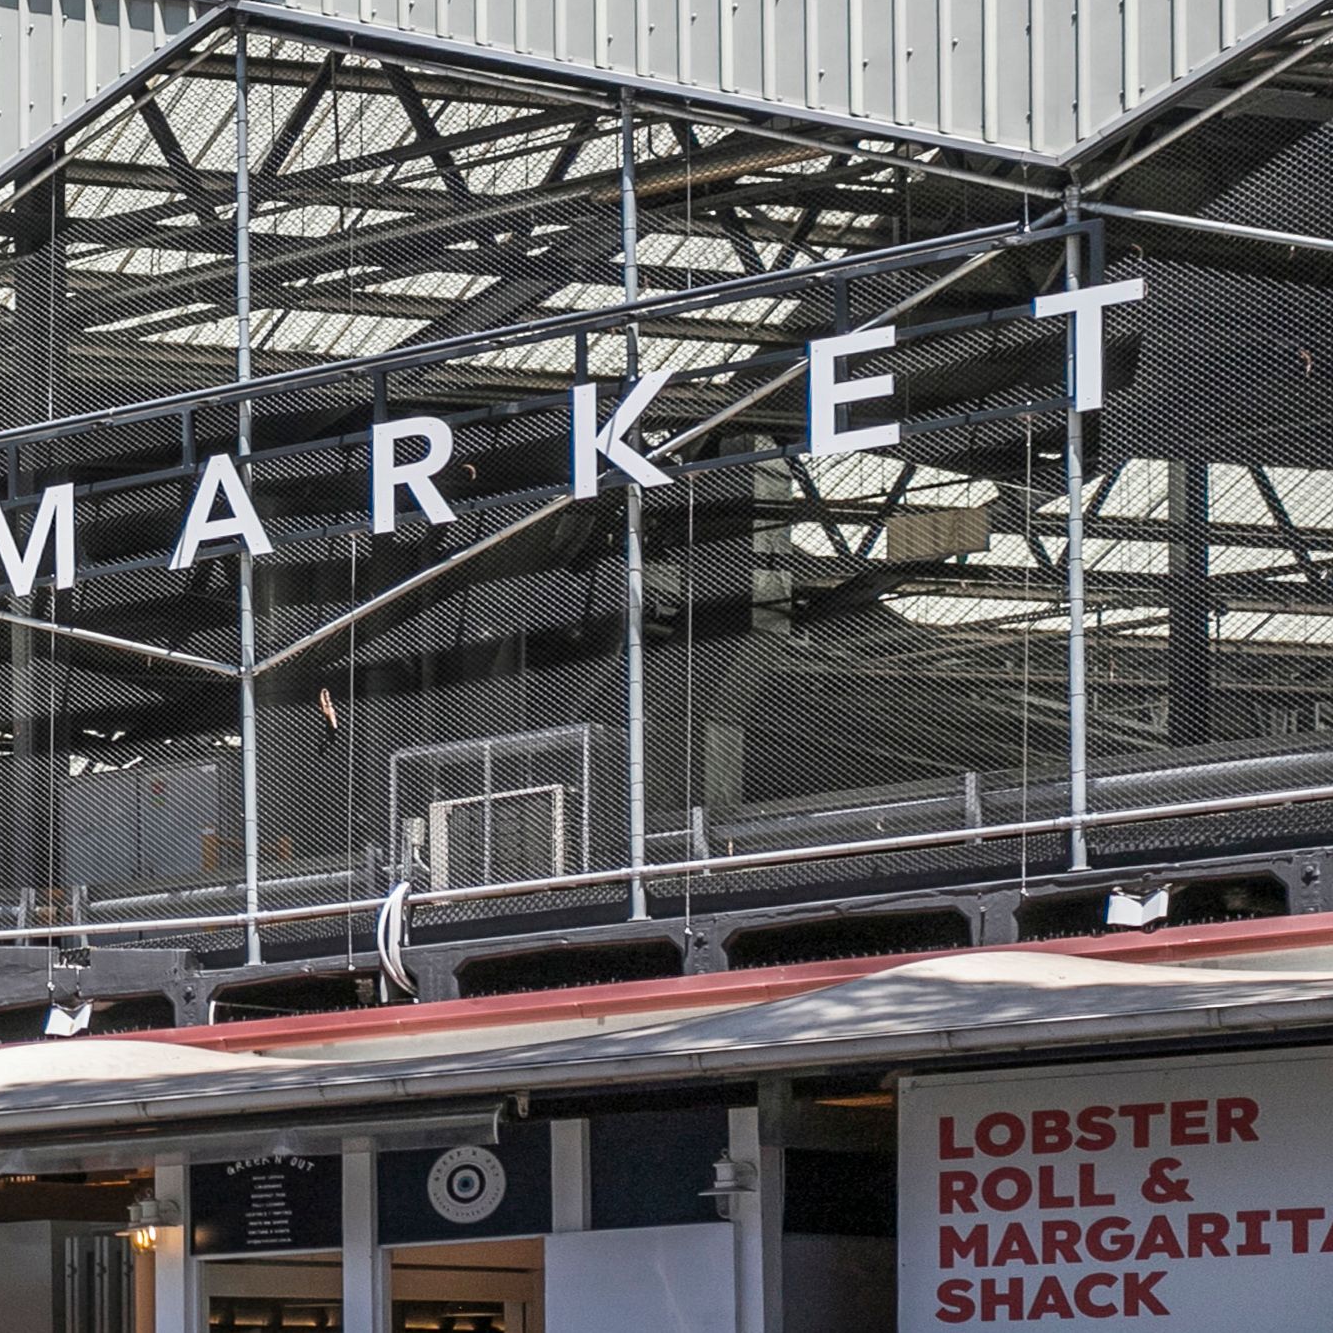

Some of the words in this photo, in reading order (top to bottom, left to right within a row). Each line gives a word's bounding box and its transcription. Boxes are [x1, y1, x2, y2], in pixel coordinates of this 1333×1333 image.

[939, 1097, 1259, 1160] LOBSTER
[939, 1163, 1116, 1214] ROLL
[1141, 1157, 1194, 1204] &
[939, 1207, 1333, 1269] MARGARIT
[935, 1271, 1171, 1323] SHACK
